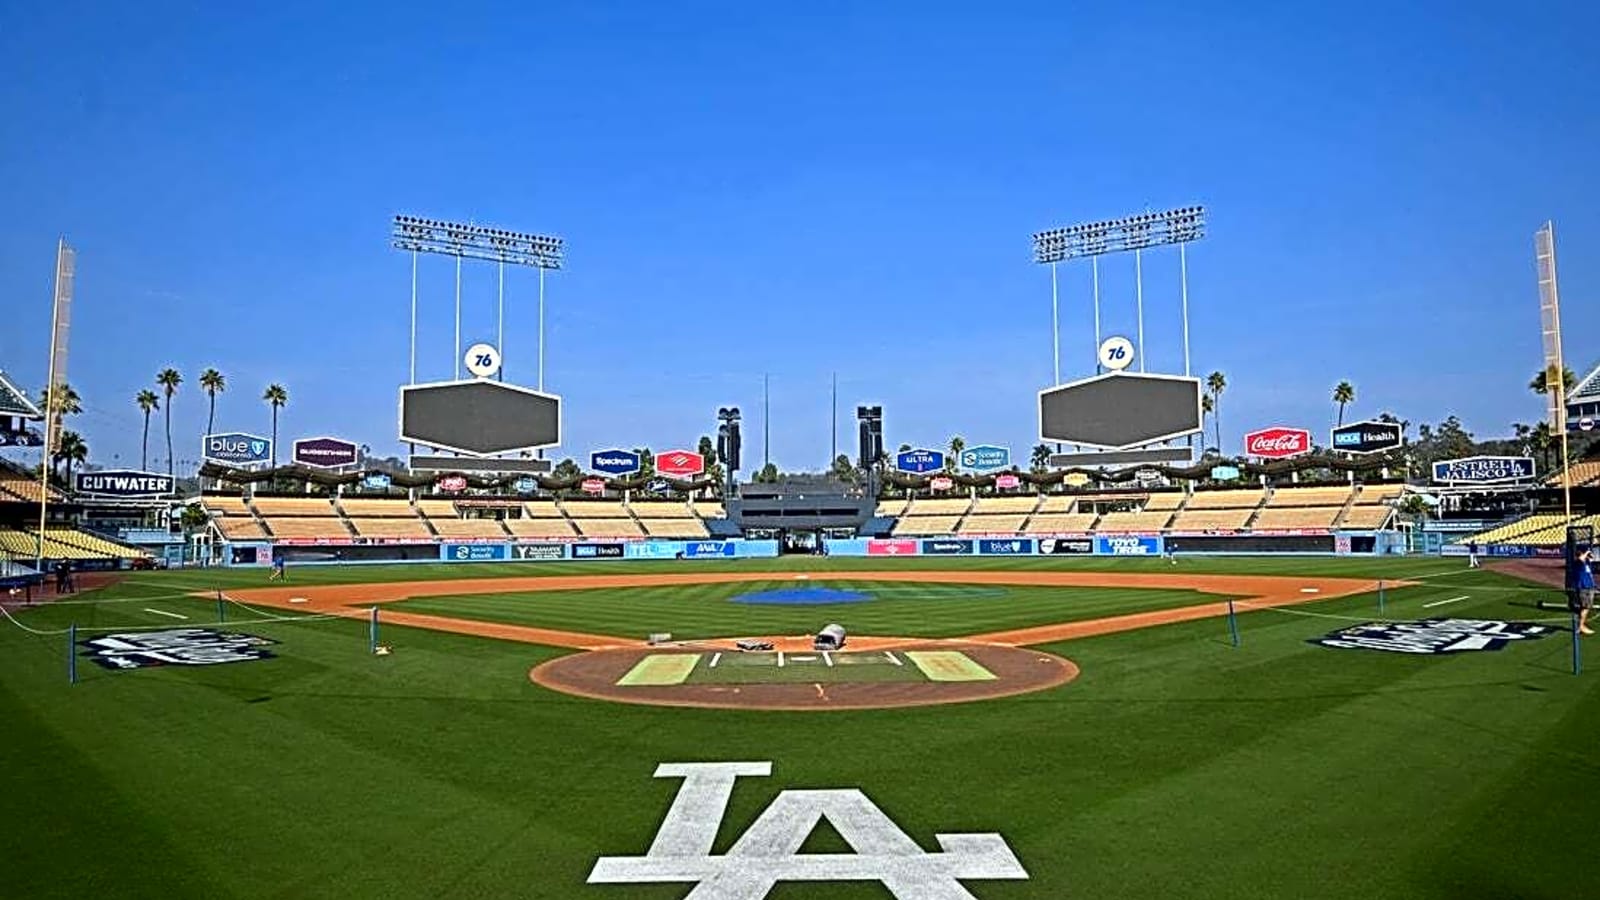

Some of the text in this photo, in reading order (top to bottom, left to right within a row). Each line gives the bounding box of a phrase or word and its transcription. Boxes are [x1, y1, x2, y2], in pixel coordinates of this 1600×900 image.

[475, 353, 493, 367] 76
[1108, 345, 1126, 361] 76
[1336, 431, 1396, 443] UCLA Health
[210, 438, 249, 452] blue
[595, 456, 634, 467] Spectrum
[906, 455, 934, 463] ULTRA
[1442, 468, 1507, 480] JALISCO
[82, 476, 167, 491] CUTWATER
[587, 761, 1029, 900] LA
